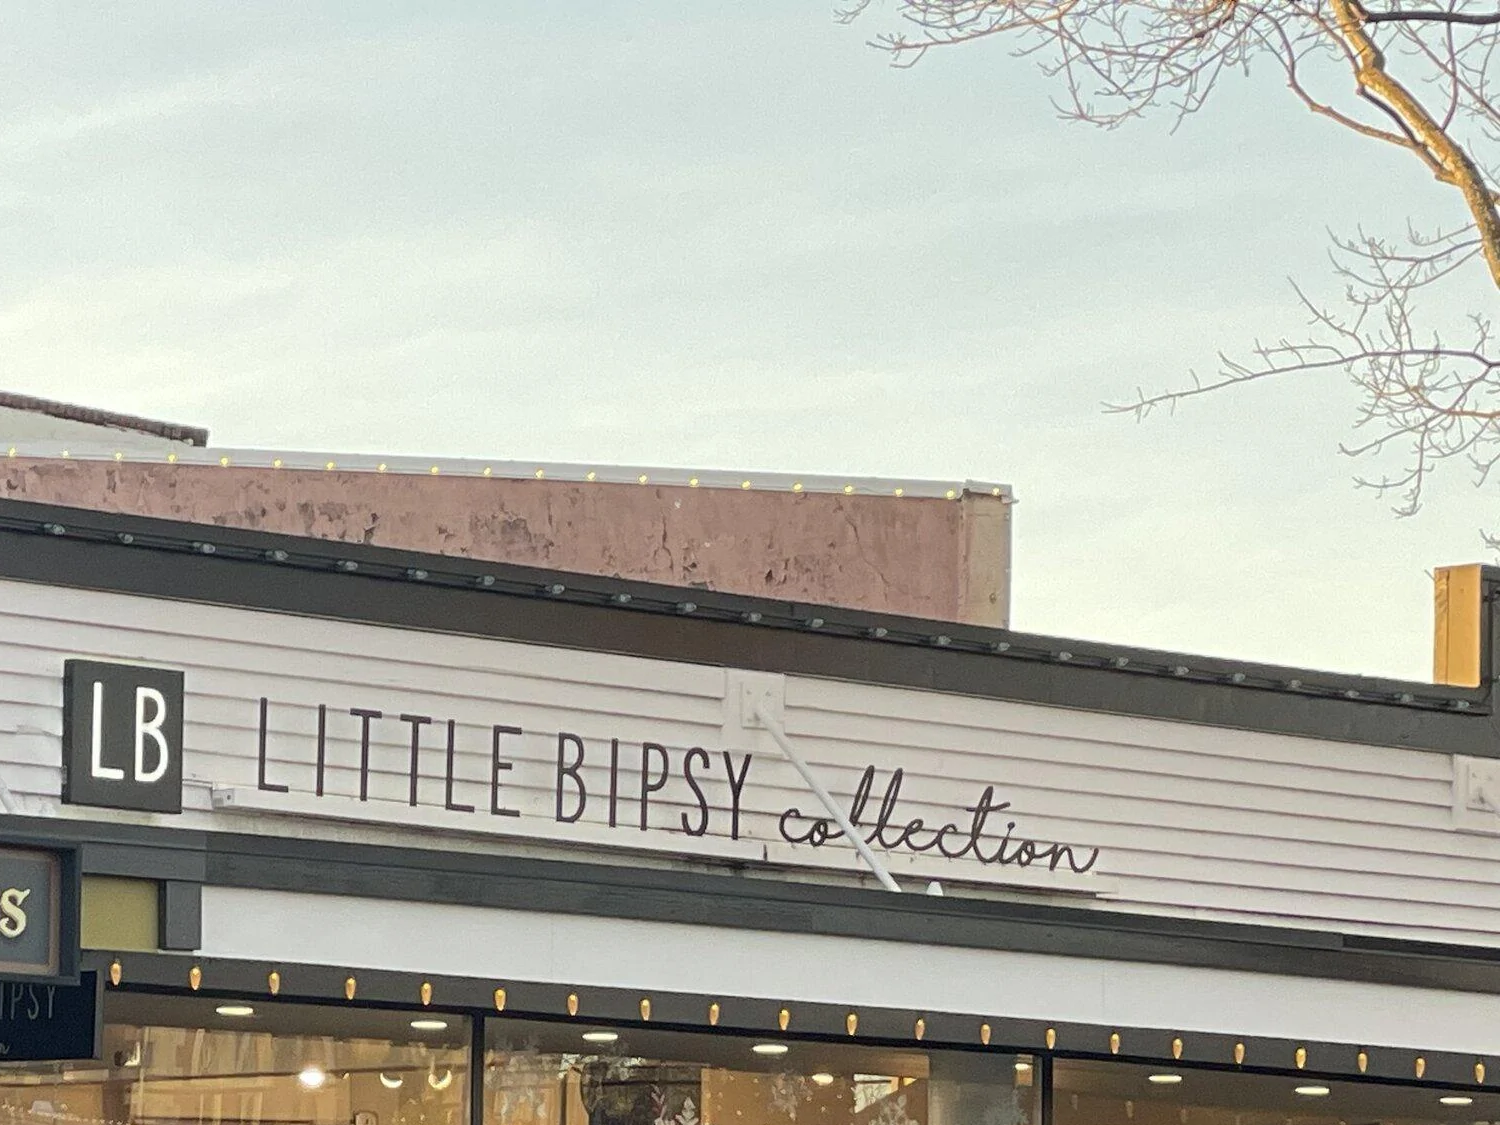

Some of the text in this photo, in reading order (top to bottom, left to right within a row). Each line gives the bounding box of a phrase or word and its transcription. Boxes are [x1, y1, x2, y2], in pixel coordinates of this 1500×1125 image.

[91, 681, 169, 783] LB
[258, 697, 1100, 874] LITTLE BIPSY collection
